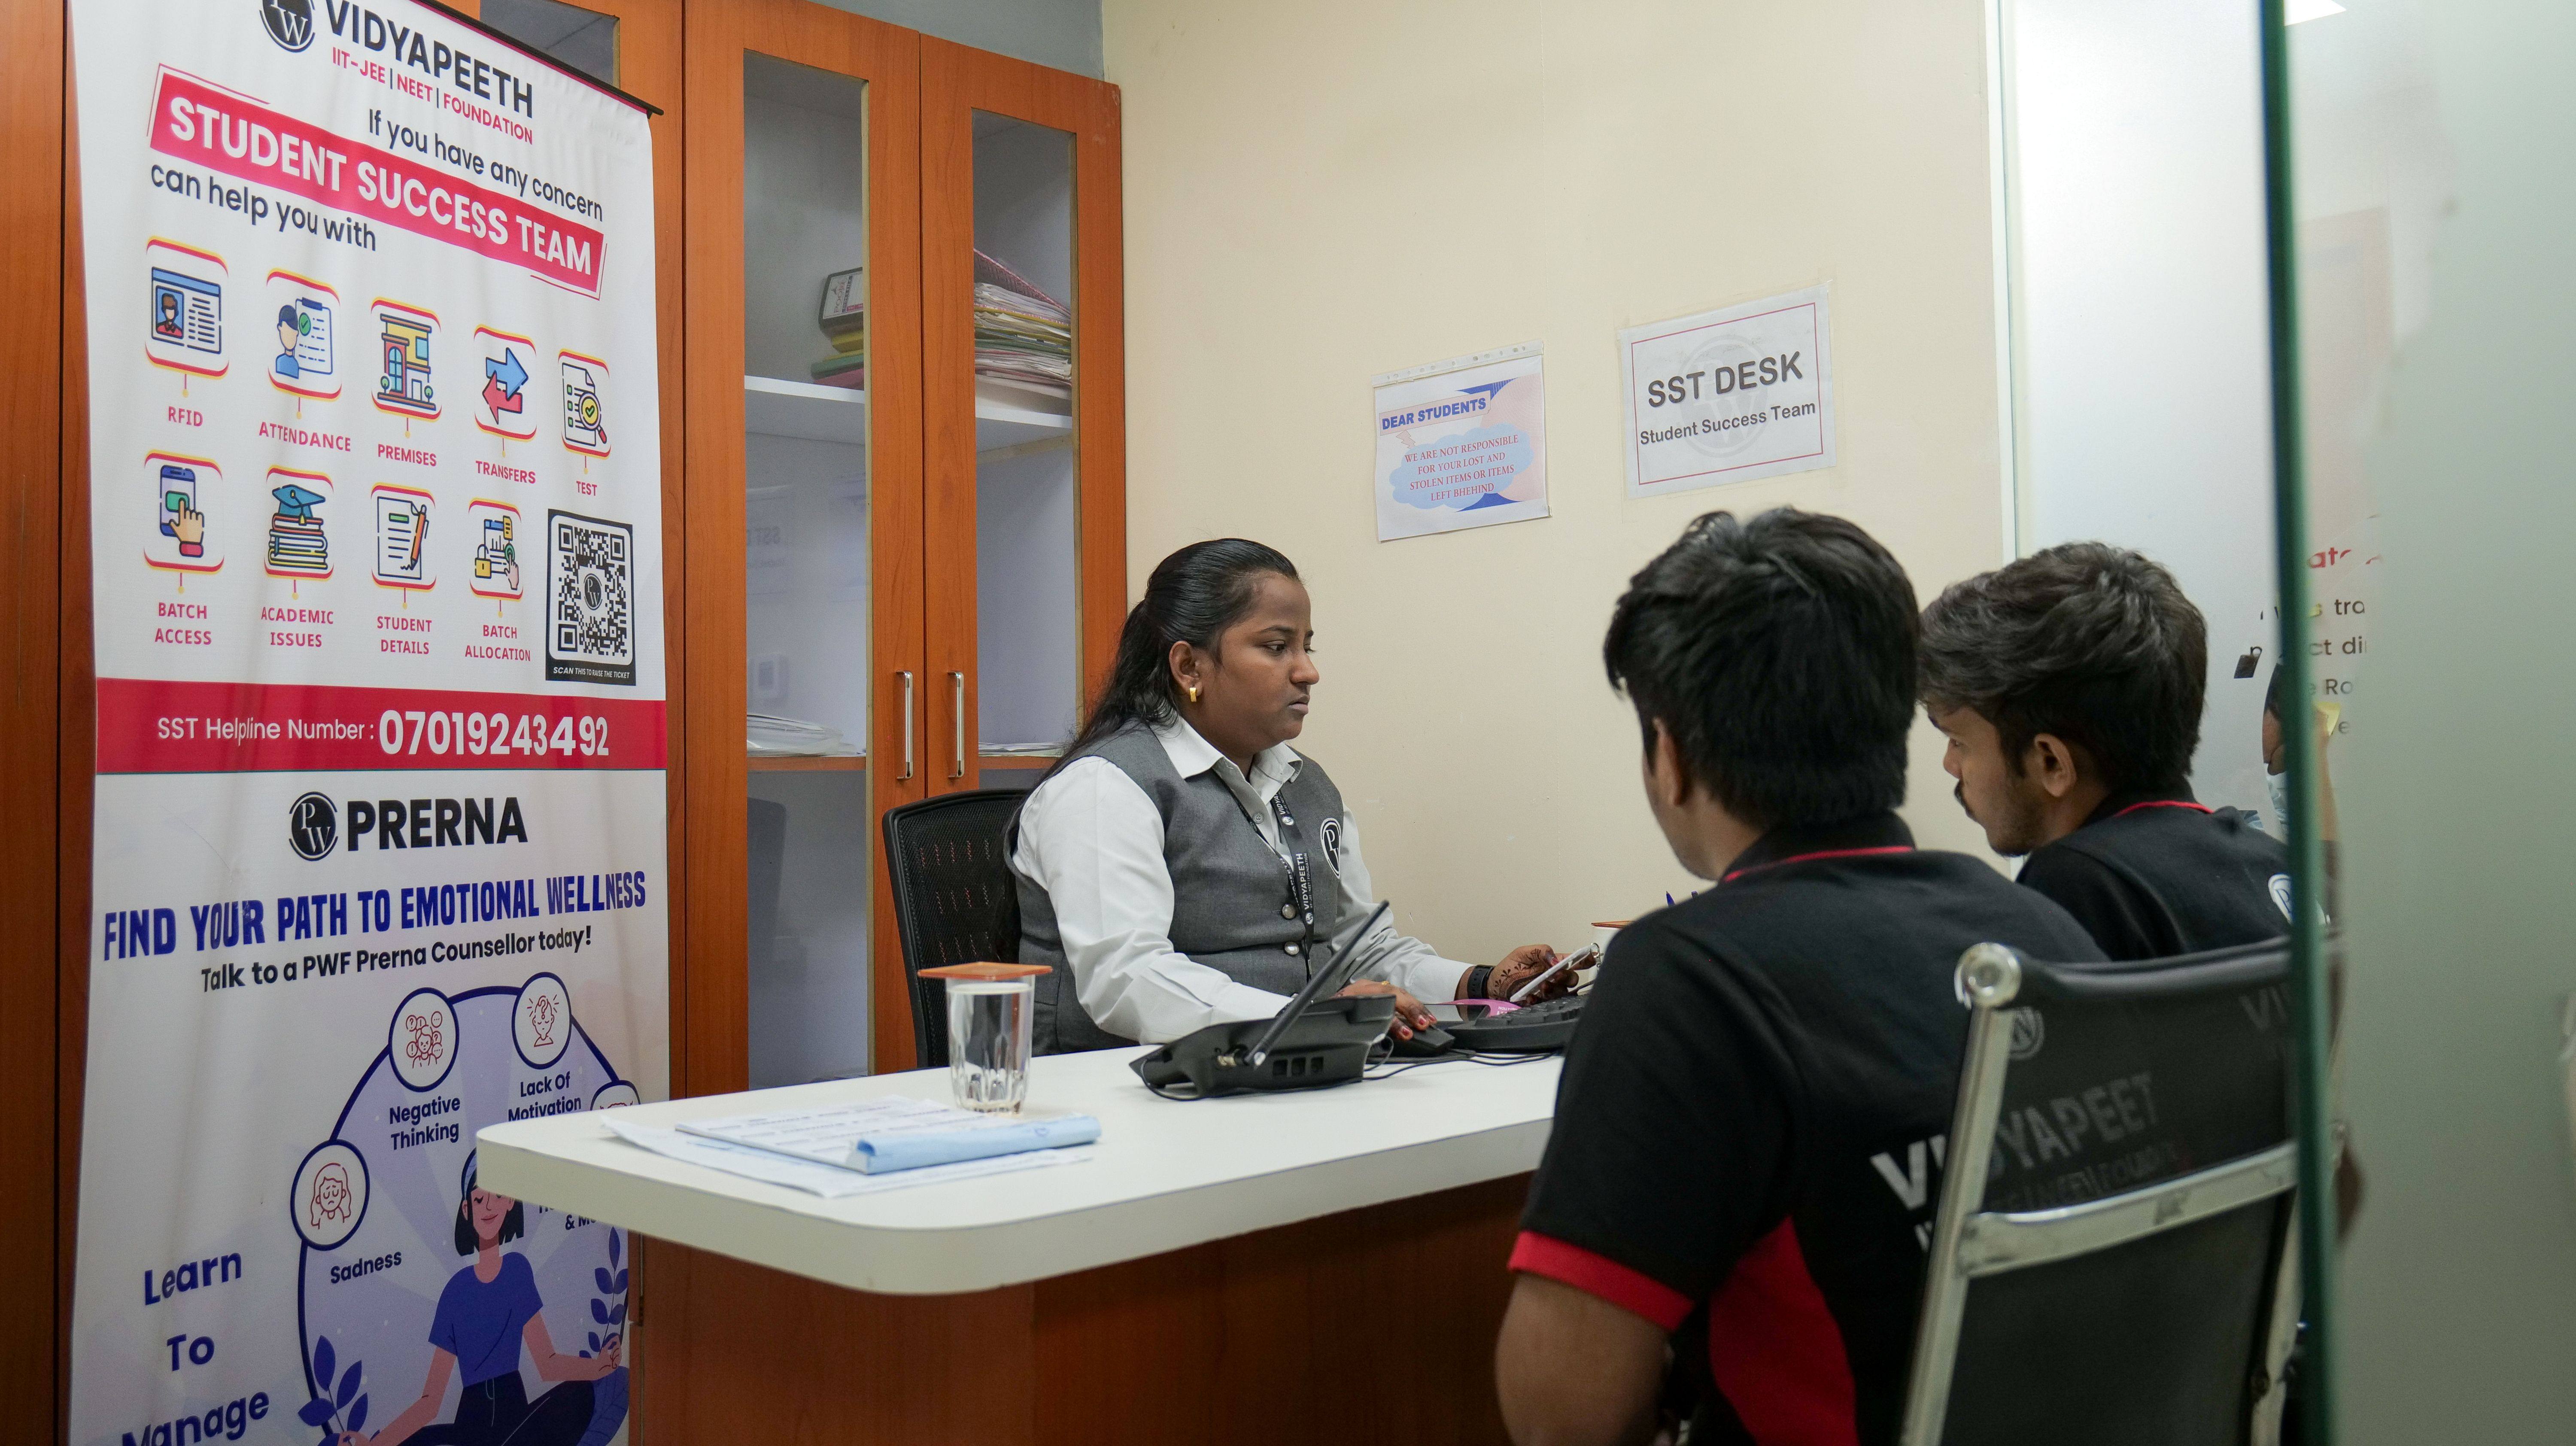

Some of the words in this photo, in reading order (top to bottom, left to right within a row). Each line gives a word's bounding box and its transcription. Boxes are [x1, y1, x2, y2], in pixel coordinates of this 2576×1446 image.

[326, 0, 532, 118] VIDYAPEETH
[332, 46, 386, 84] IIT-JEE
[397, 73, 433, 102] NEET
[444, 93, 533, 145] FOUNDATION
[369, 109, 382, 136] If
[387, 120, 428, 154] you
[434, 132, 484, 175] have
[491, 161, 528, 198] any
[532, 177, 604, 222] concern
[170, 96, 347, 192] STUDENT
[358, 162, 509, 245] SUCCESS
[516, 217, 591, 275] TEAM
[150, 163, 200, 200] can
[210, 176, 269, 226] help
[276, 200, 318, 236] you
[322, 216, 376, 252] with
[1648, 371, 1705, 408] SST
[1715, 351, 1803, 395] DESK
[168, 406, 204, 427] RFID
[1382, 412, 1414, 430] DEAR
[1418, 397, 1486, 422] STUDENTS
[1640, 422, 1698, 445] Student
[1701, 411, 1767, 434] Success
[1771, 403, 1816, 421] Team
[259, 422, 351, 452] ATTENDANCE
[1405, 453, 1418, 464] WE
[1420, 450, 1437, 462] ARE
[1440, 446, 1459, 458] NOT
[1461, 434, 1519, 454] RESPONSIBLE
[378, 444, 437, 467] PREMISES
[1418, 465, 1436, 475] FOR
[1438, 461, 1462, 472] YOUR
[1463, 456, 1484, 468] LOST
[1487, 452, 1506, 464] AND
[475, 460, 536, 484] TRANSFERS
[1410, 478, 1444, 491] STOLEN
[1446, 473, 1472, 485] ITEMS
[1473, 470, 1486, 480] OR
[1488, 464, 1515, 477] ITEMS
[576, 480, 598, 497] TEST
[1431, 491, 1452, 501] LEFT
[1454, 483, 1495, 498] BHEHIND
[158, 602, 207, 619] BATCH
[261, 606, 334, 625] ACADEMIC
[377, 616, 432, 633] STUDENT
[155, 628, 212, 645] ACCESS
[270, 632, 322, 648] ISSUES
[483, 624, 518, 639] BATCH
[380, 639, 430, 655] DETAILS
[465, 645, 532, 662] ALLOCATION
[158, 717, 197, 741] SST
[206, 717, 281, 747] Helpline
[288, 718, 365, 741] Number
[379, 709, 610, 756] 07019243492
[346, 796, 529, 852] PRERNA
[1296, 853, 1310, 910] VIDYAPEETH
[103, 907, 176, 962] FIND
[191, 899, 264, 951] YOUR
[277, 892, 345, 942] PATH
[358, 889, 391, 933] TO
[401, 878, 540, 930] EMOTIONAL
[545, 870, 646, 917] WELLNESS
[200, 962, 246, 993] Talk
[252, 958, 278, 985] to
[283, 961, 297, 981] a
[302, 951, 352, 979] PWF
[356, 944, 427, 974] Prerna
[431, 930, 535, 963] Counsellor
[538, 925, 592, 952] today!
[520, 1076, 552, 1098] Lack
[555, 1071, 571, 1091] Of
[389, 1095, 461, 1124] Negative
[508, 1095, 581, 1122] Motivation
[391, 1122, 460, 1150] Thinking
[144, 1252, 242, 1306] Learn
[330, 1251, 402, 1284] Sadness
[166, 1334, 215, 1372] To
